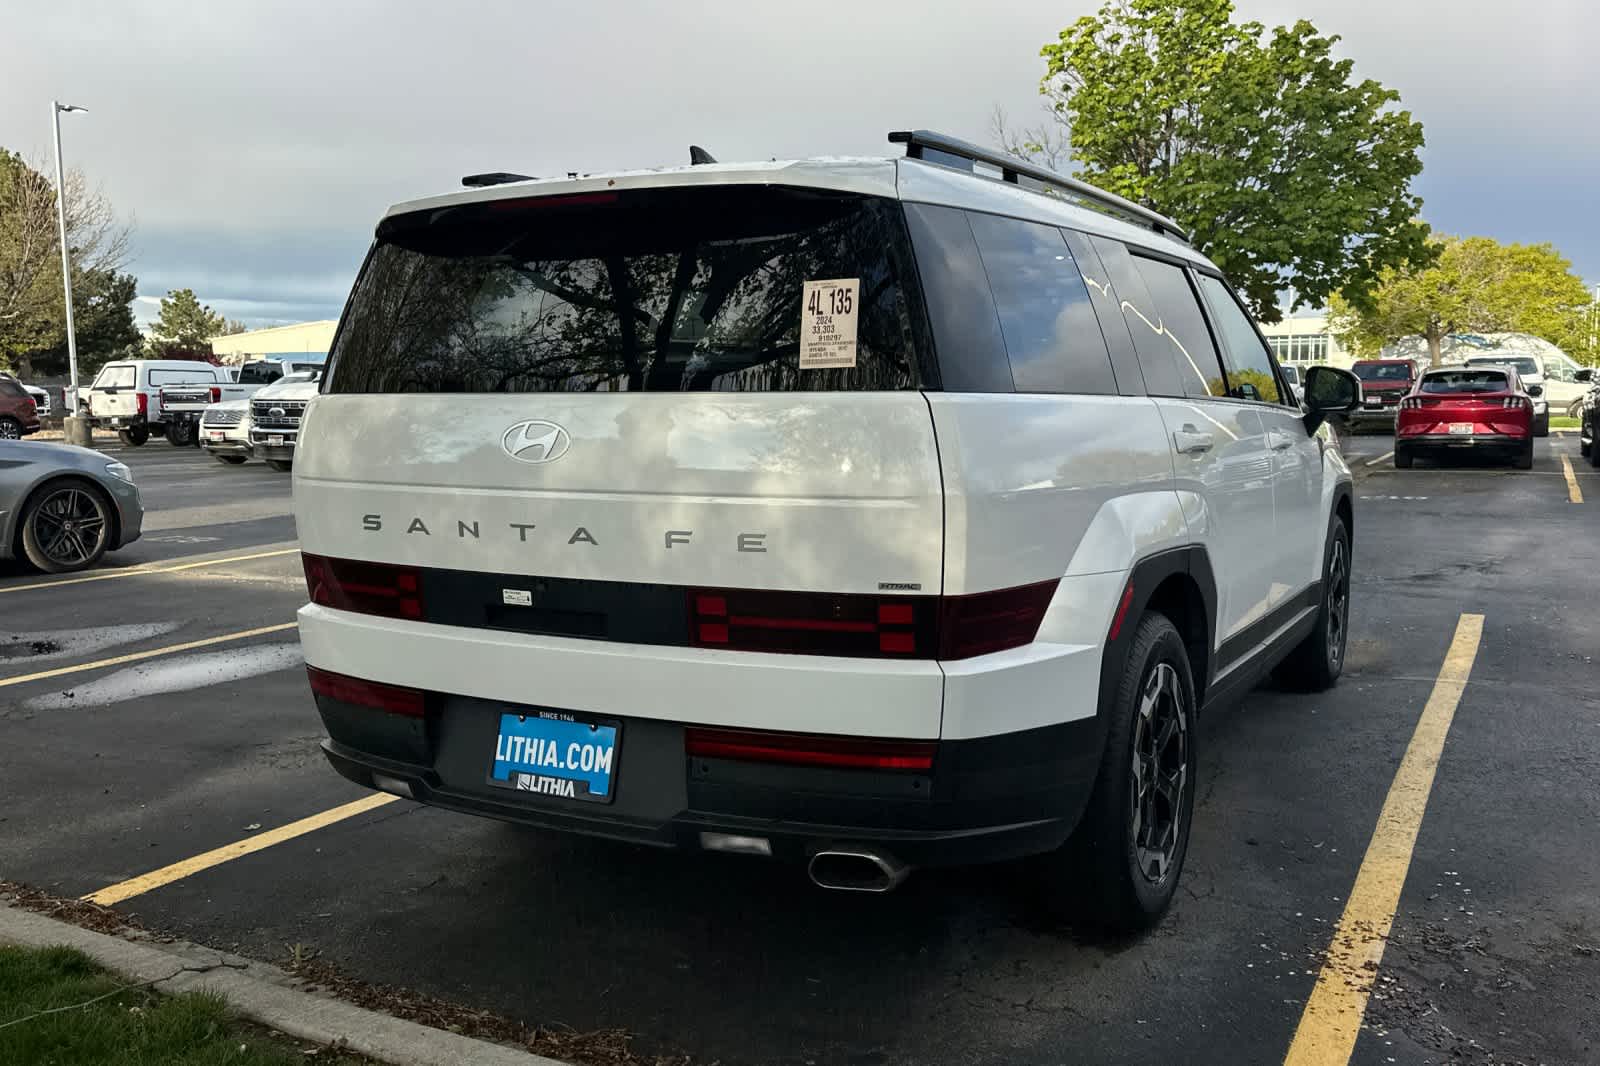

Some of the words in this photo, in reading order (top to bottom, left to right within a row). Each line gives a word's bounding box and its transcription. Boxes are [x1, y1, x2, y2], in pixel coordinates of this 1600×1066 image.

[808, 290, 823, 316] 4L
[829, 288, 852, 315] 135
[816, 316, 832, 325] 2024
[363, 514, 599, 546] SANTA
[665, 531, 767, 552] FE
[539, 711, 558, 720] SINCE
[495, 734, 614, 775] LITHIA.COM
[529, 775, 575, 798] LITHIA
